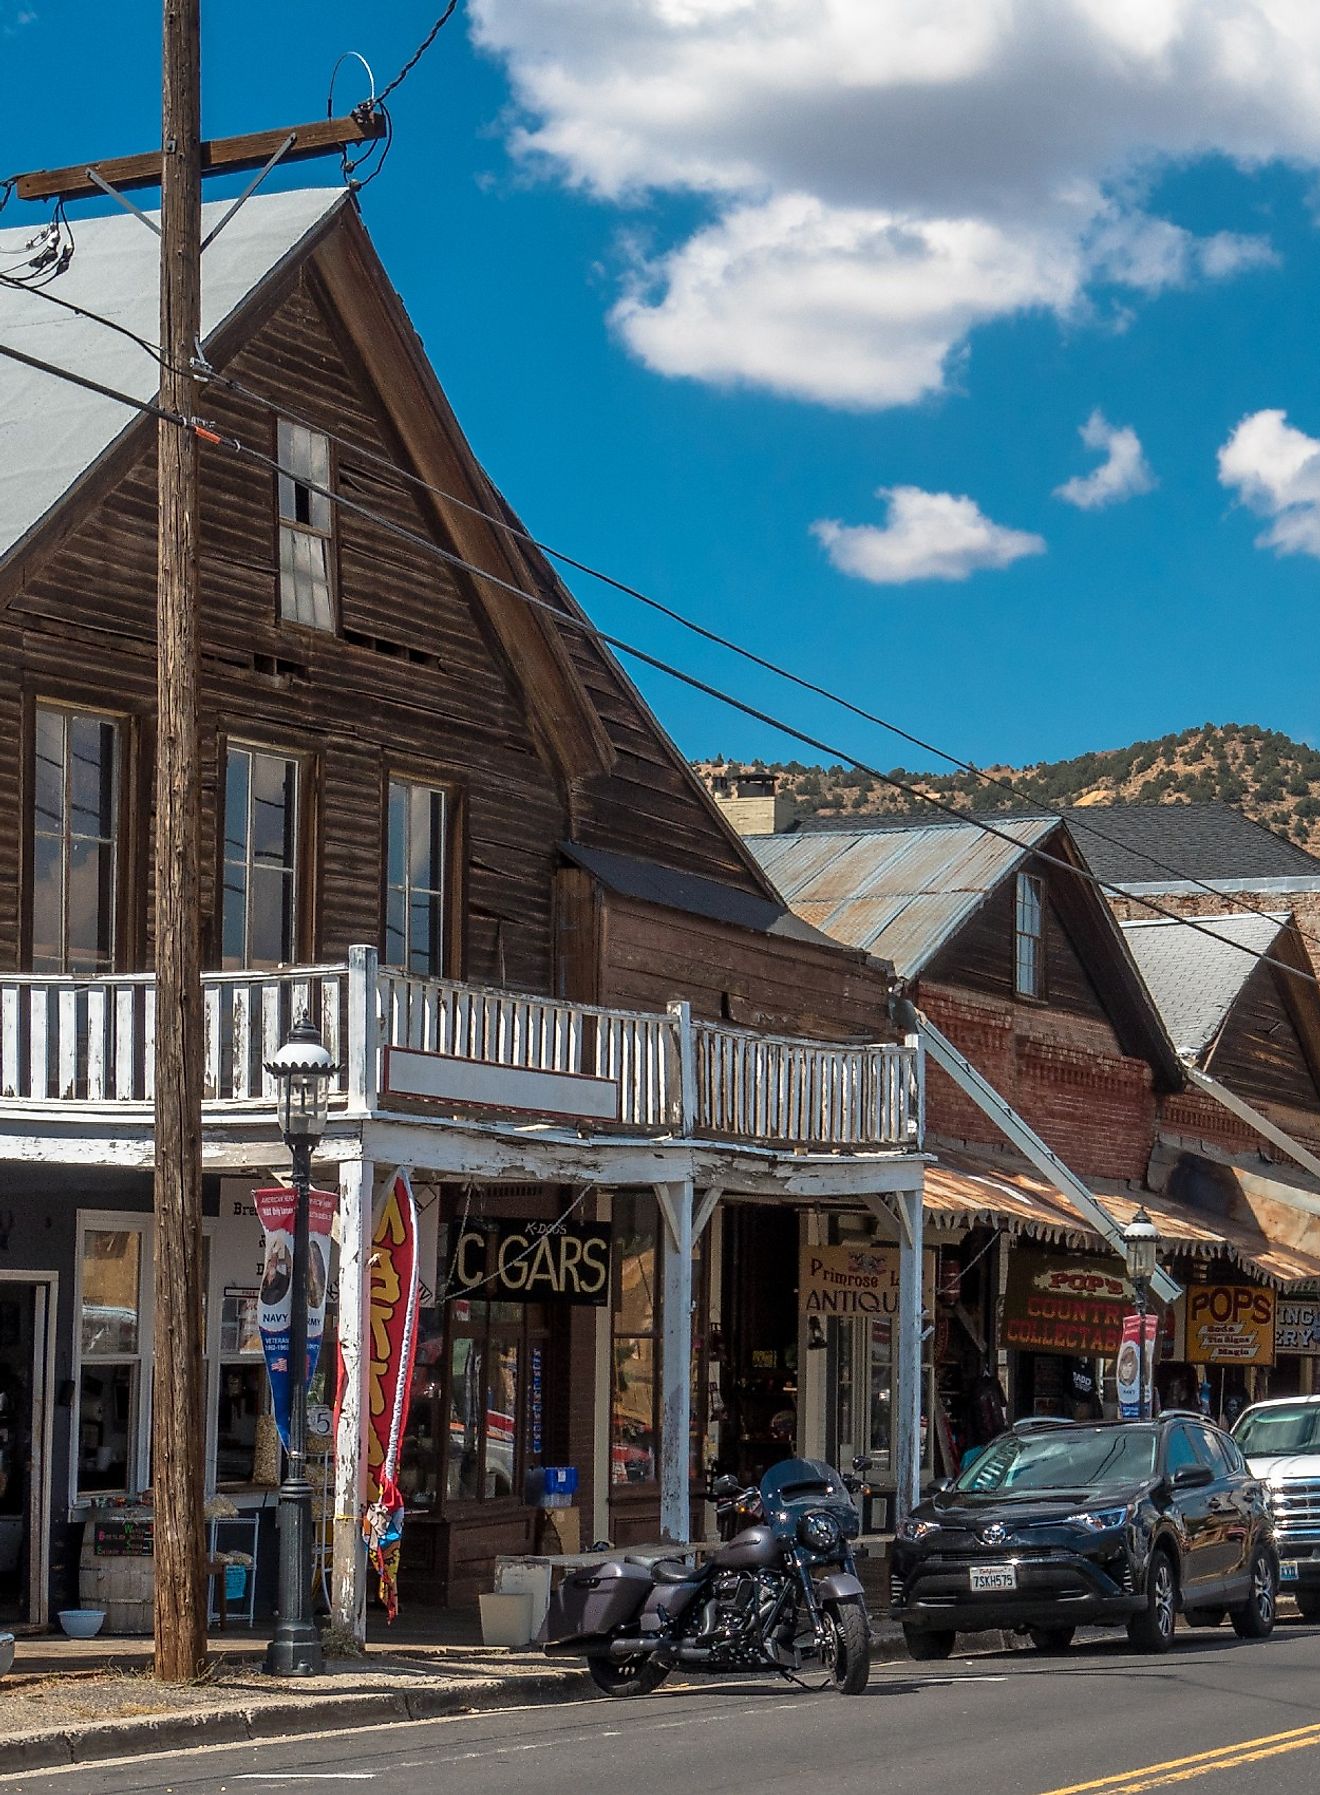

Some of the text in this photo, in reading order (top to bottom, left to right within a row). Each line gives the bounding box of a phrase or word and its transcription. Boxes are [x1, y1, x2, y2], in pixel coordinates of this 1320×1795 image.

[810, 1258, 878, 1288] Primrose
[1049, 1273, 1124, 1295] POP'S
[806, 1289, 926, 1313] ANTIQU
[1192, 1288, 1272, 1325] POPS
[263, 1313, 289, 1323] NAVY
[1277, 1307, 1313, 1326] ING
[1007, 1319, 1121, 1351] COLLECTAB
[1275, 1329, 1313, 1348] ERY
[972, 1574, 1013, 1588] 7SKH575
